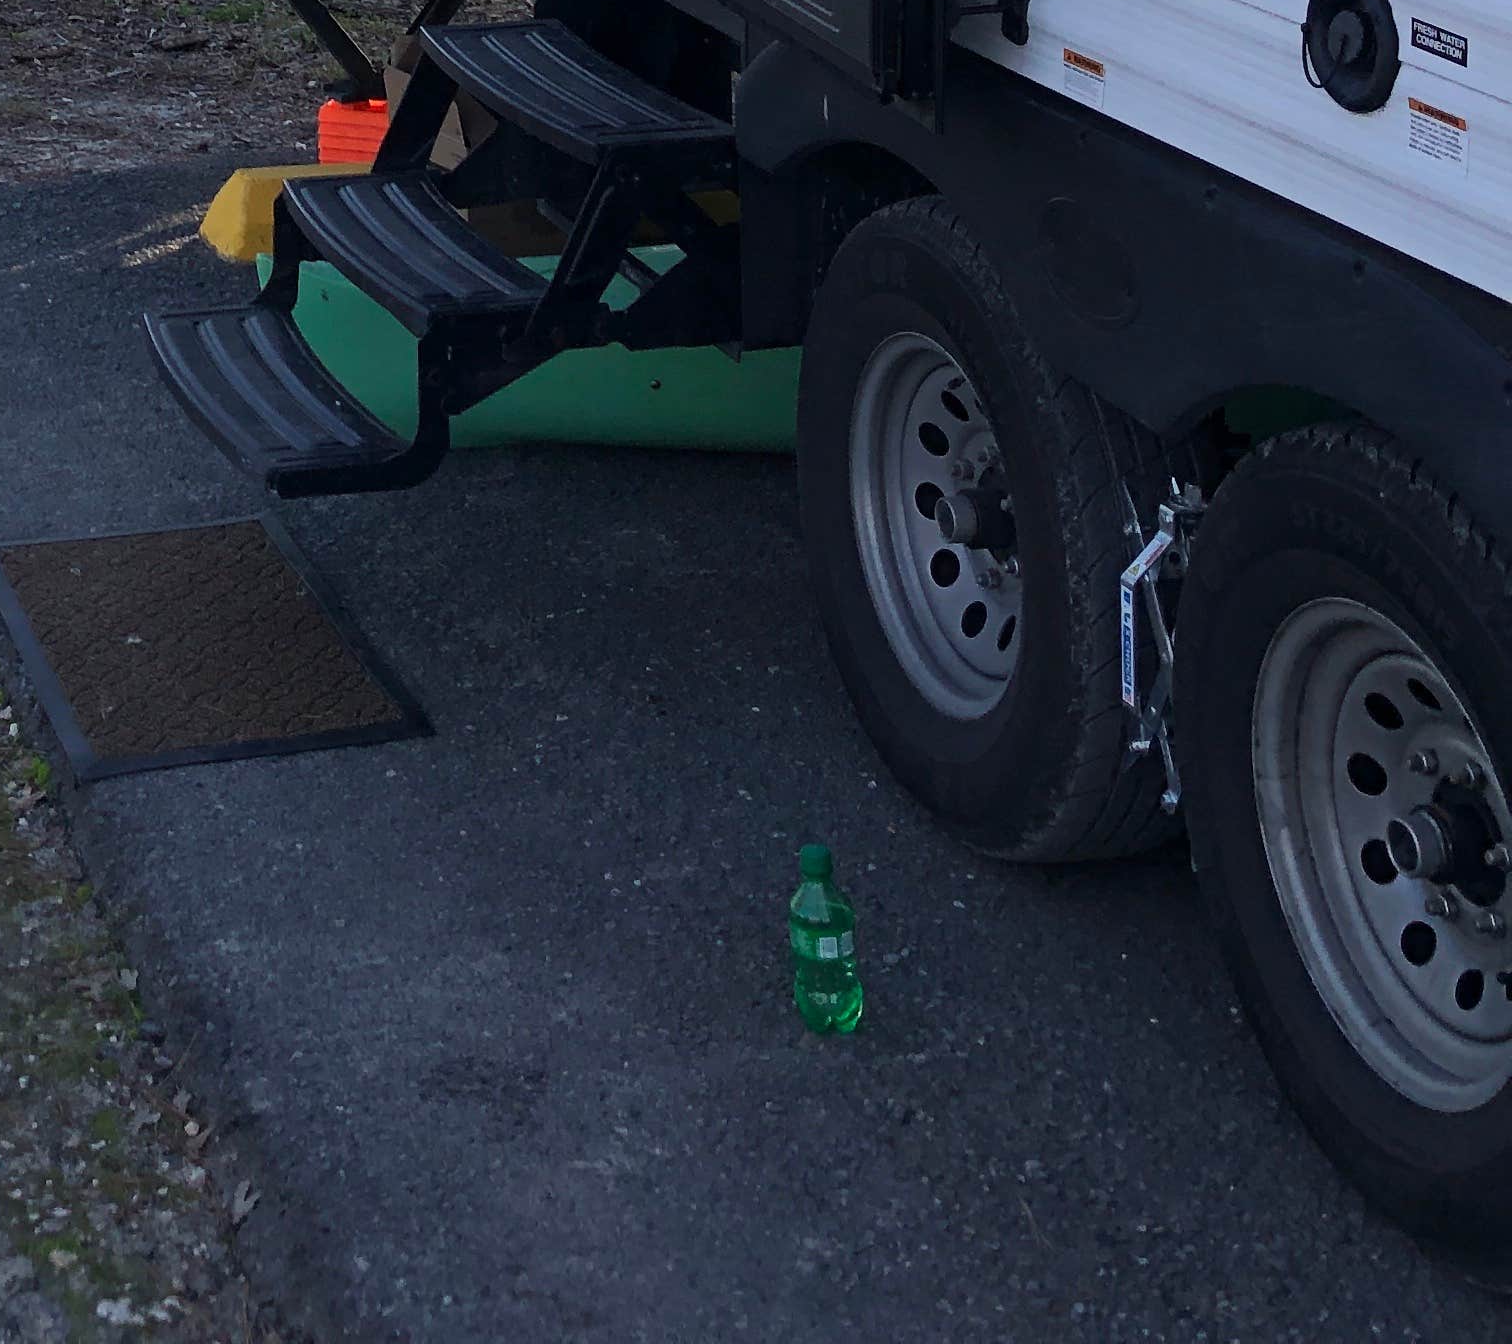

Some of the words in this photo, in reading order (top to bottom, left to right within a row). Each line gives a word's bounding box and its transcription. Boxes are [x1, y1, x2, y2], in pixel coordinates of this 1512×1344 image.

[1413, 22, 1437, 39] FRESH
[1439, 31, 1466, 50] WATER
[1416, 33, 1463, 60] CONNECTION
